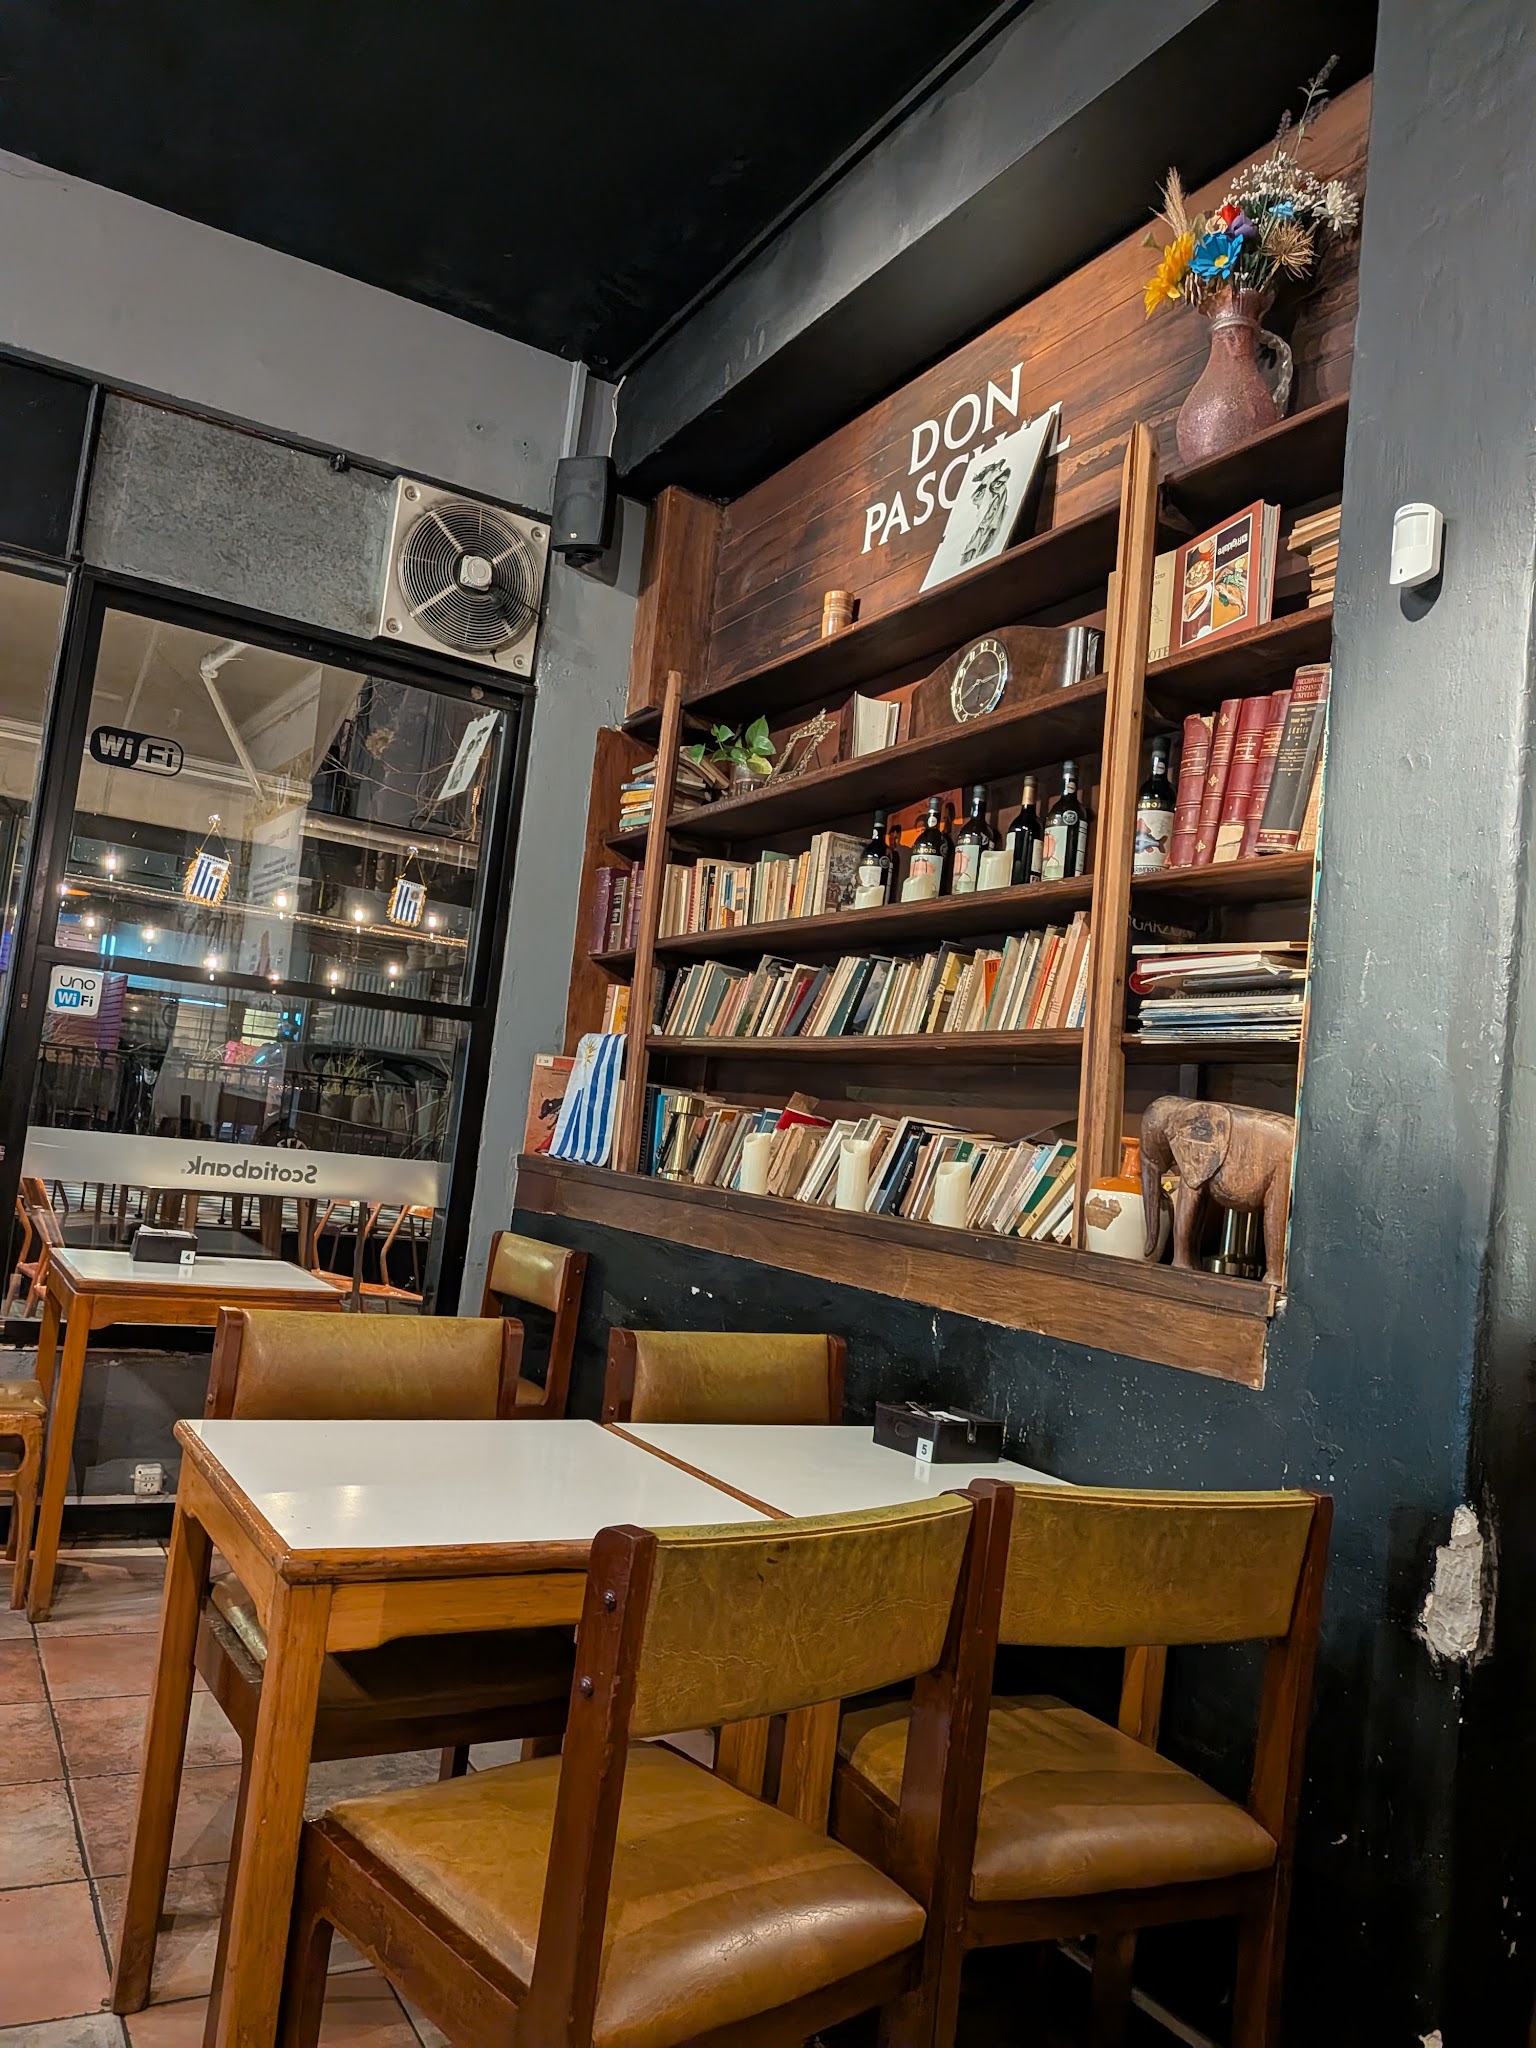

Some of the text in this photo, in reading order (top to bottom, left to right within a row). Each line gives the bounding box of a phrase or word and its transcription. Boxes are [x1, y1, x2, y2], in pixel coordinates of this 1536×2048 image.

[908, 361, 1024, 475] DON
[861, 400, 1071, 554] PASCL
[988, 962, 998, 974] 10
[921, 1443, 928, 1456] 5
